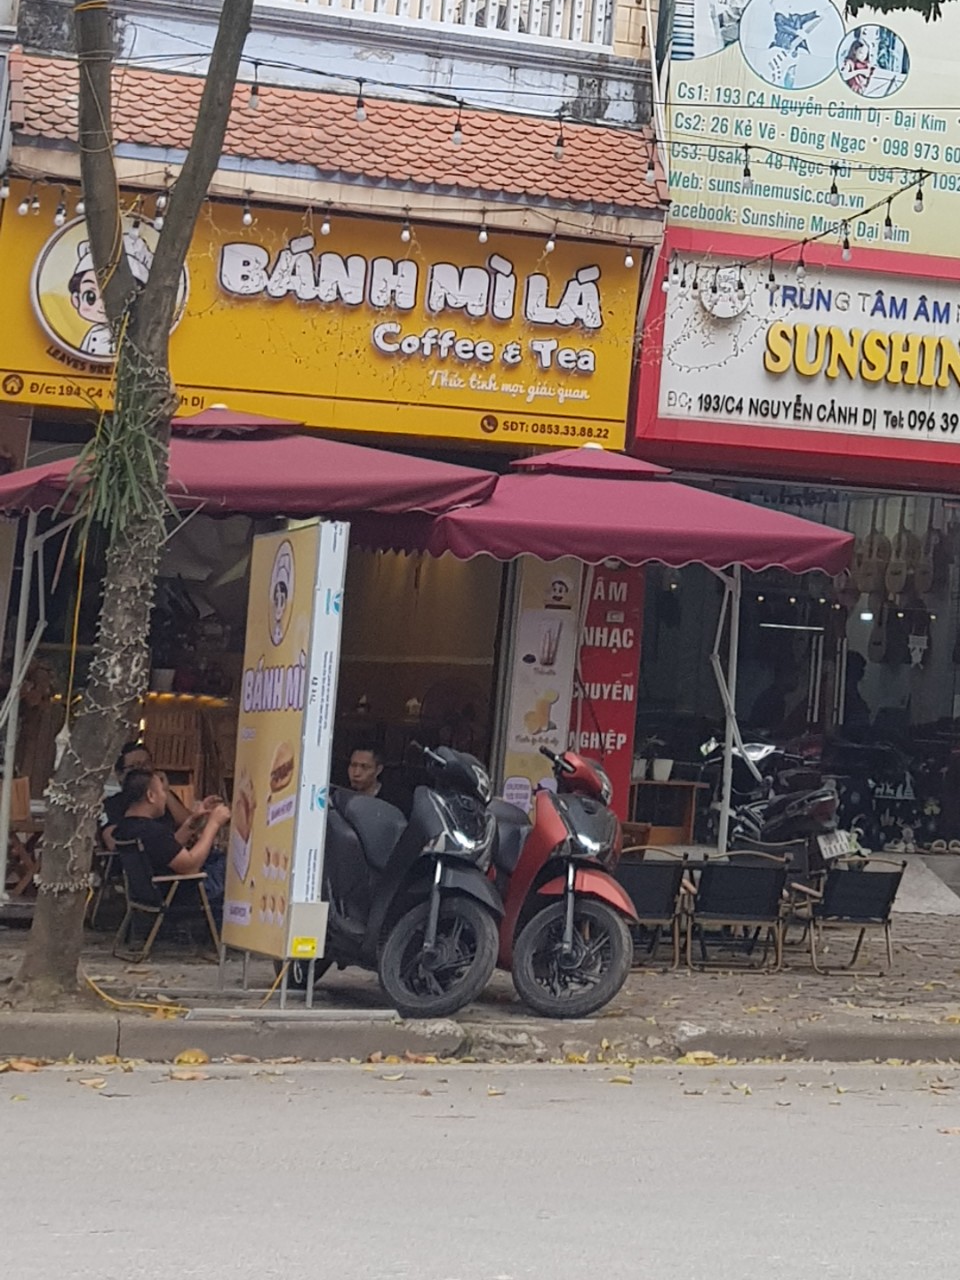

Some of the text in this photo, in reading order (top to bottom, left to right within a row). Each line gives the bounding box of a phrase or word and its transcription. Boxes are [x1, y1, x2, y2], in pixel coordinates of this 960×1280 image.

[677, 81, 709, 102] Cs1:
[715, 87, 741, 105] 193
[746, 91, 765, 107] C4
[770, 95, 823, 118] Nguyễn
[828, 100, 862, 122] Cảnh
[867, 106, 881, 128] Dị
[894, 109, 916, 131] Đại
[920, 114, 947, 133] Kim
[674, 112, 705, 132] Cs2:
[710, 116, 729, 134] 26
[734, 116, 752, 137] Kẻ
[758, 121, 776, 141] Vẽ
[789, 126, 826, 150] Đông
[830, 131, 867, 156] Ngạc
[882, 138, 909, 157] 098
[913, 142, 940, 161] 973
[671, 141, 703, 161] Cs3:
[765, 152, 783, 171] 48
[788, 157, 825, 181] Ngọc
[868, 167, 894, 184] 094
[668, 171, 703, 191] Web:
[671, 202, 738, 224] acebook:
[741, 208, 805, 231] Sunshine
[856, 220, 879, 241] Đại
[220, 233, 604, 329] BÁNH MÌ LÁ
[768, 283, 850, 313] TRUNG
[857, 288, 908, 321] TÂM
[912, 295, 951, 324] ÂM
[372, 321, 597, 373] Coffee & Tea
[29, 382, 57, 396] Đ/c:
[502, 420, 610, 440] SĐT: 0853.33.88.22
[697, 393, 744, 416] 193/C4
[748, 394, 813, 421] NGUYỄN
[816, 399, 858, 424] CẢNH
[862, 408, 877, 431] DỊ
[907, 410, 936, 432] 096
[940, 412, 960, 433] 39
[593, 576, 628, 602] ÂM
[579, 626, 635, 654] NHẠC
[243, 653, 285, 714] BÁNH
[283, 648, 307, 712] MÌ
